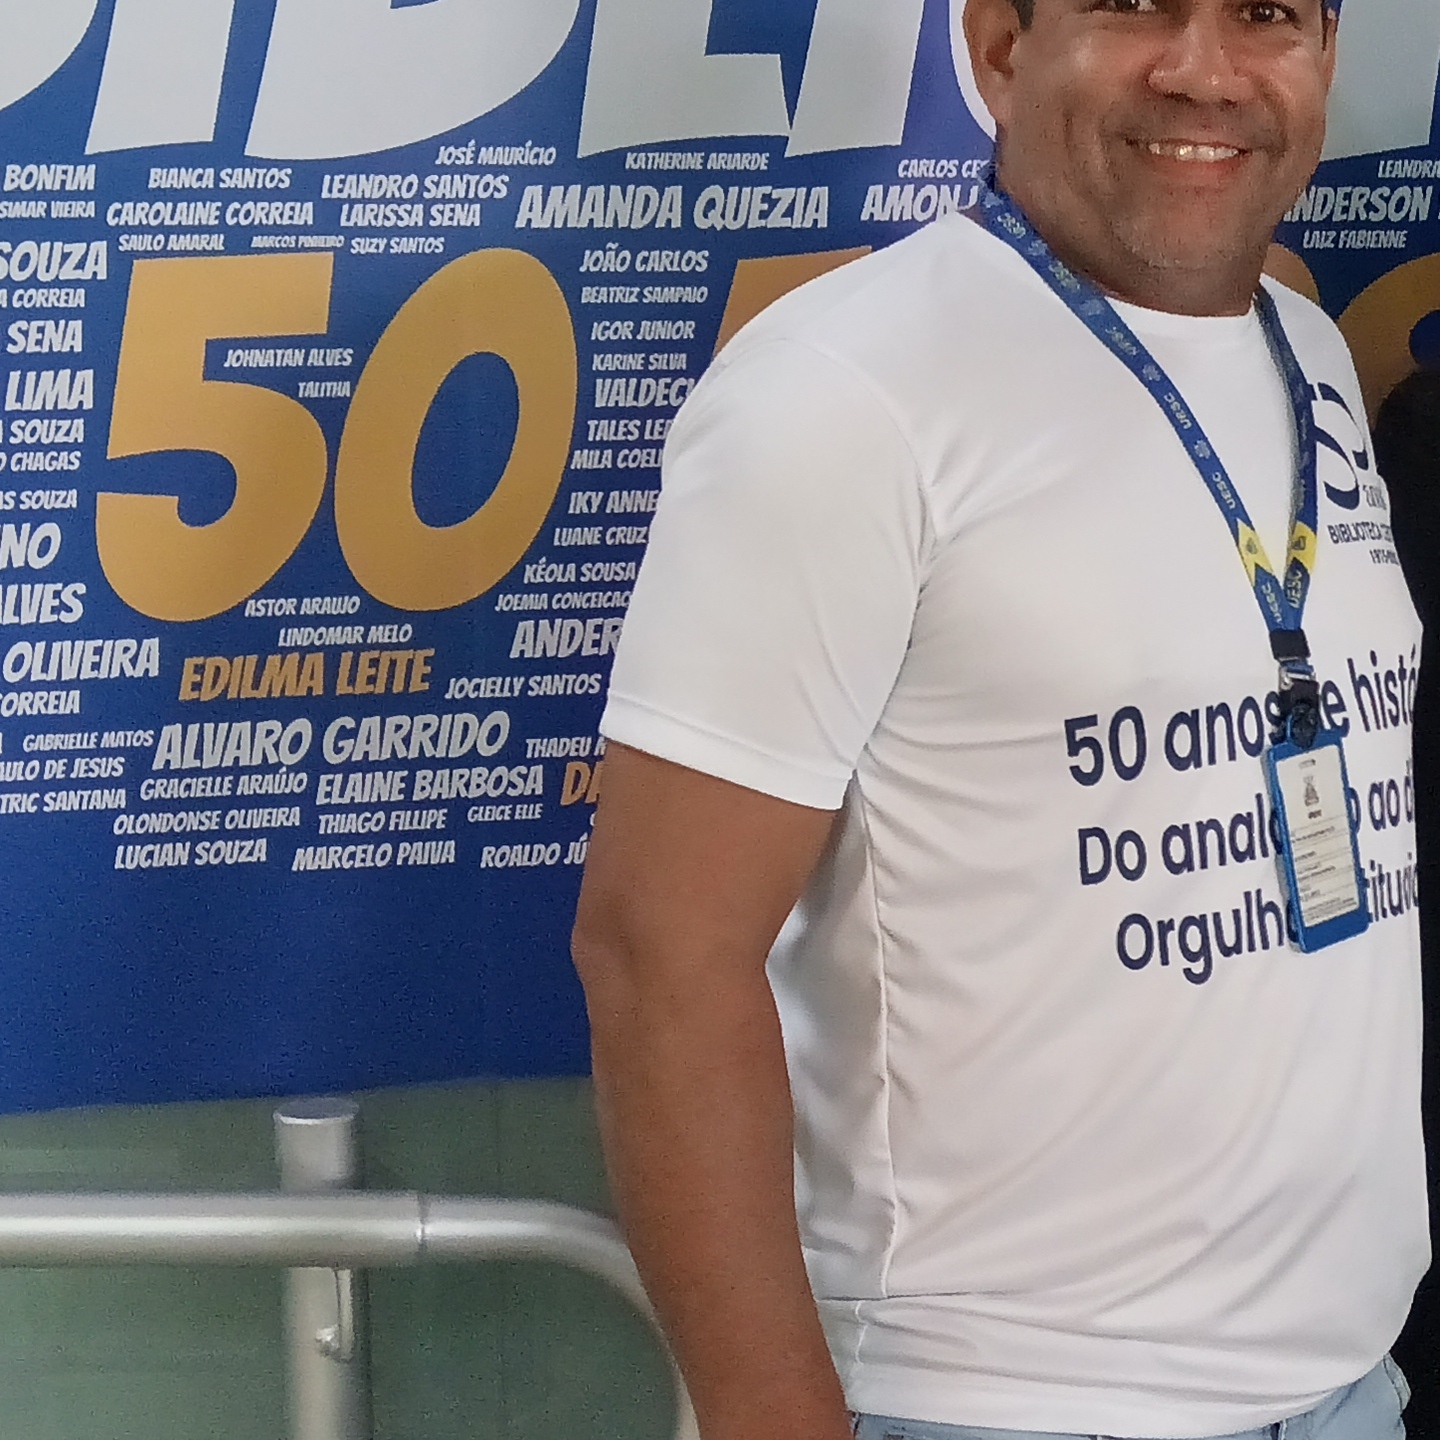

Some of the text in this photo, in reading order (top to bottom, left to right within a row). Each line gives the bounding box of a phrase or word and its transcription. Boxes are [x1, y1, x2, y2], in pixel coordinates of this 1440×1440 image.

[96, 248, 577, 622] 50
[179, 649, 434, 701] EDILMA LEITE
[152, 711, 510, 770] ALVARO GARRIDO
[1064, 706, 1148, 787] 50
[1078, 825, 1148, 886] Do
[1368, 778, 1401, 832] ao
